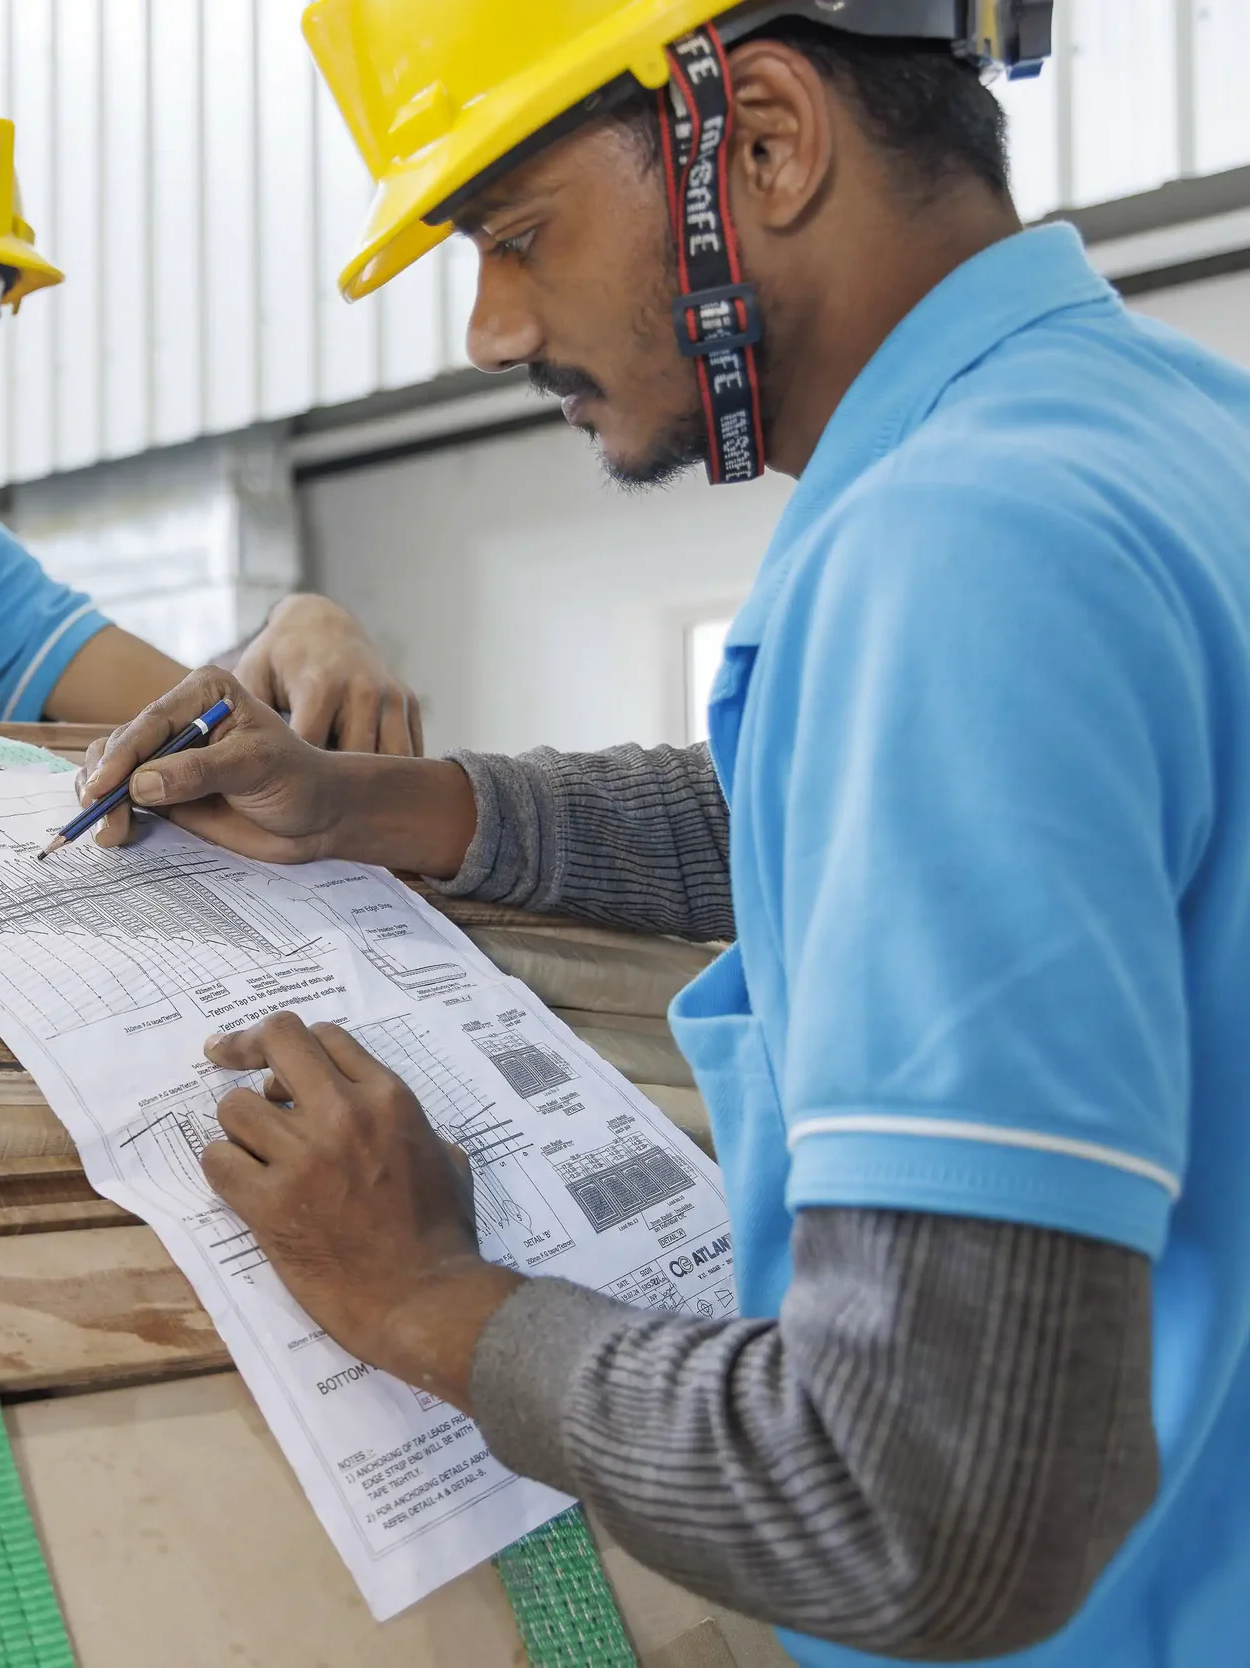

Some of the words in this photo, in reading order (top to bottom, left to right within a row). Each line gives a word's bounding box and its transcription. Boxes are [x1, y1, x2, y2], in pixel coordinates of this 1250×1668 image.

[199, 988, 228, 1002] tape/Tetron
[210, 1003, 235, 1018] Tetron
[233, 997, 249, 1008] Tap
[247, 993, 257, 1002] to
[257, 989, 266, 998] be
[301, 979, 308, 987] of
[308, 976, 324, 985] each
[151, 1013, 179, 1026] tape/Tetron
[219, 1016, 246, 1034] Tetron
[245, 1010, 260, 1022] Tap
[259, 1006, 269, 1016] to
[270, 1003, 279, 1012] be
[313, 991, 320, 999] of
[320, 987, 336, 997] each
[168, 1080, 199, 1095] tape/Tetron
[523, 1235, 545, 1249] DETAIL
[548, 1240, 573, 1253] tape/Tetron
[660, 1233, 678, 1246] DETAIL
[639, 1267, 653, 1277] SIGN
[616, 1279, 630, 1289] DATE
[316, 1363, 369, 1395] BOTTOM
[356, 1447, 403, 1478] ANCHORING
[402, 1441, 412, 1453] OF
[412, 1434, 426, 1447] TAP
[427, 1421, 451, 1439] LEADS
[450, 1412, 468, 1427] FRO
[338, 1450, 366, 1470] NOTES
[361, 1472, 385, 1490] EDGE
[384, 1459, 407, 1477] STRIP
[407, 1451, 424, 1465] END
[423, 1441, 443, 1456] WILL
[442, 1434, 454, 1446] BE
[452, 1423, 473, 1440] WITH
[367, 1485, 390, 1500] TAPE
[388, 1467, 423, 1490] TIGHTLY.
[376, 1503, 393, 1517] FOR
[393, 1477, 440, 1508] ANCHORING
[438, 1460, 470, 1482] DETAILS
[469, 1447, 490, 1466] ABOV
[382, 1512, 409, 1530] REFER
[408, 1492, 444, 1517] DETAIL-A
[443, 1487, 452, 1497] &
